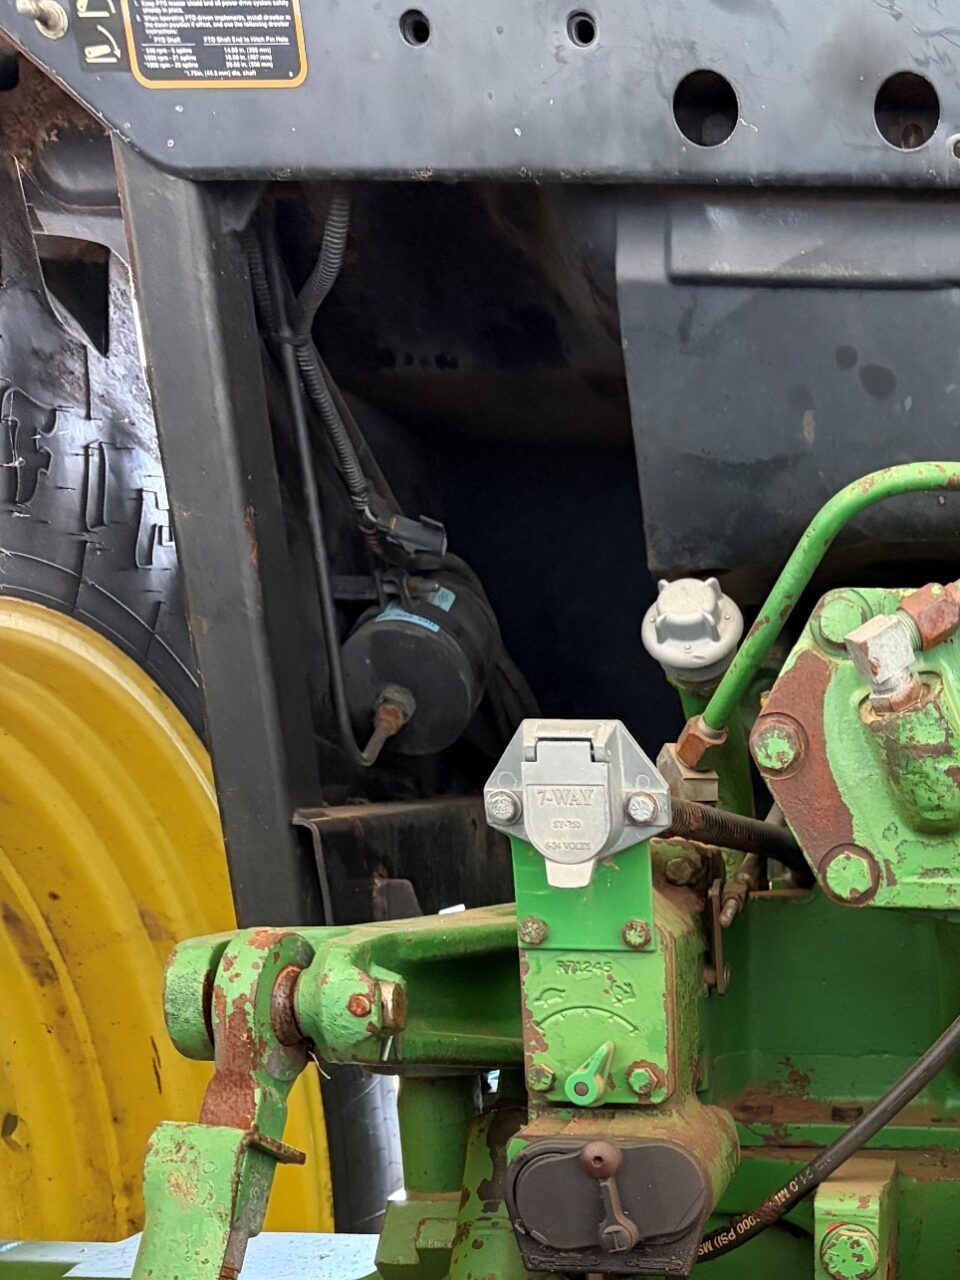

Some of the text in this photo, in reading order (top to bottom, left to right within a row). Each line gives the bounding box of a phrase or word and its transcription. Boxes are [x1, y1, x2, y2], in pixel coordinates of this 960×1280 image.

[536, 788, 594, 807] 7-WAY
[562, 840, 592, 851] VOLTS
[714, 1228, 737, 1248] PSI)
[697, 1239, 713, 1256] MS
